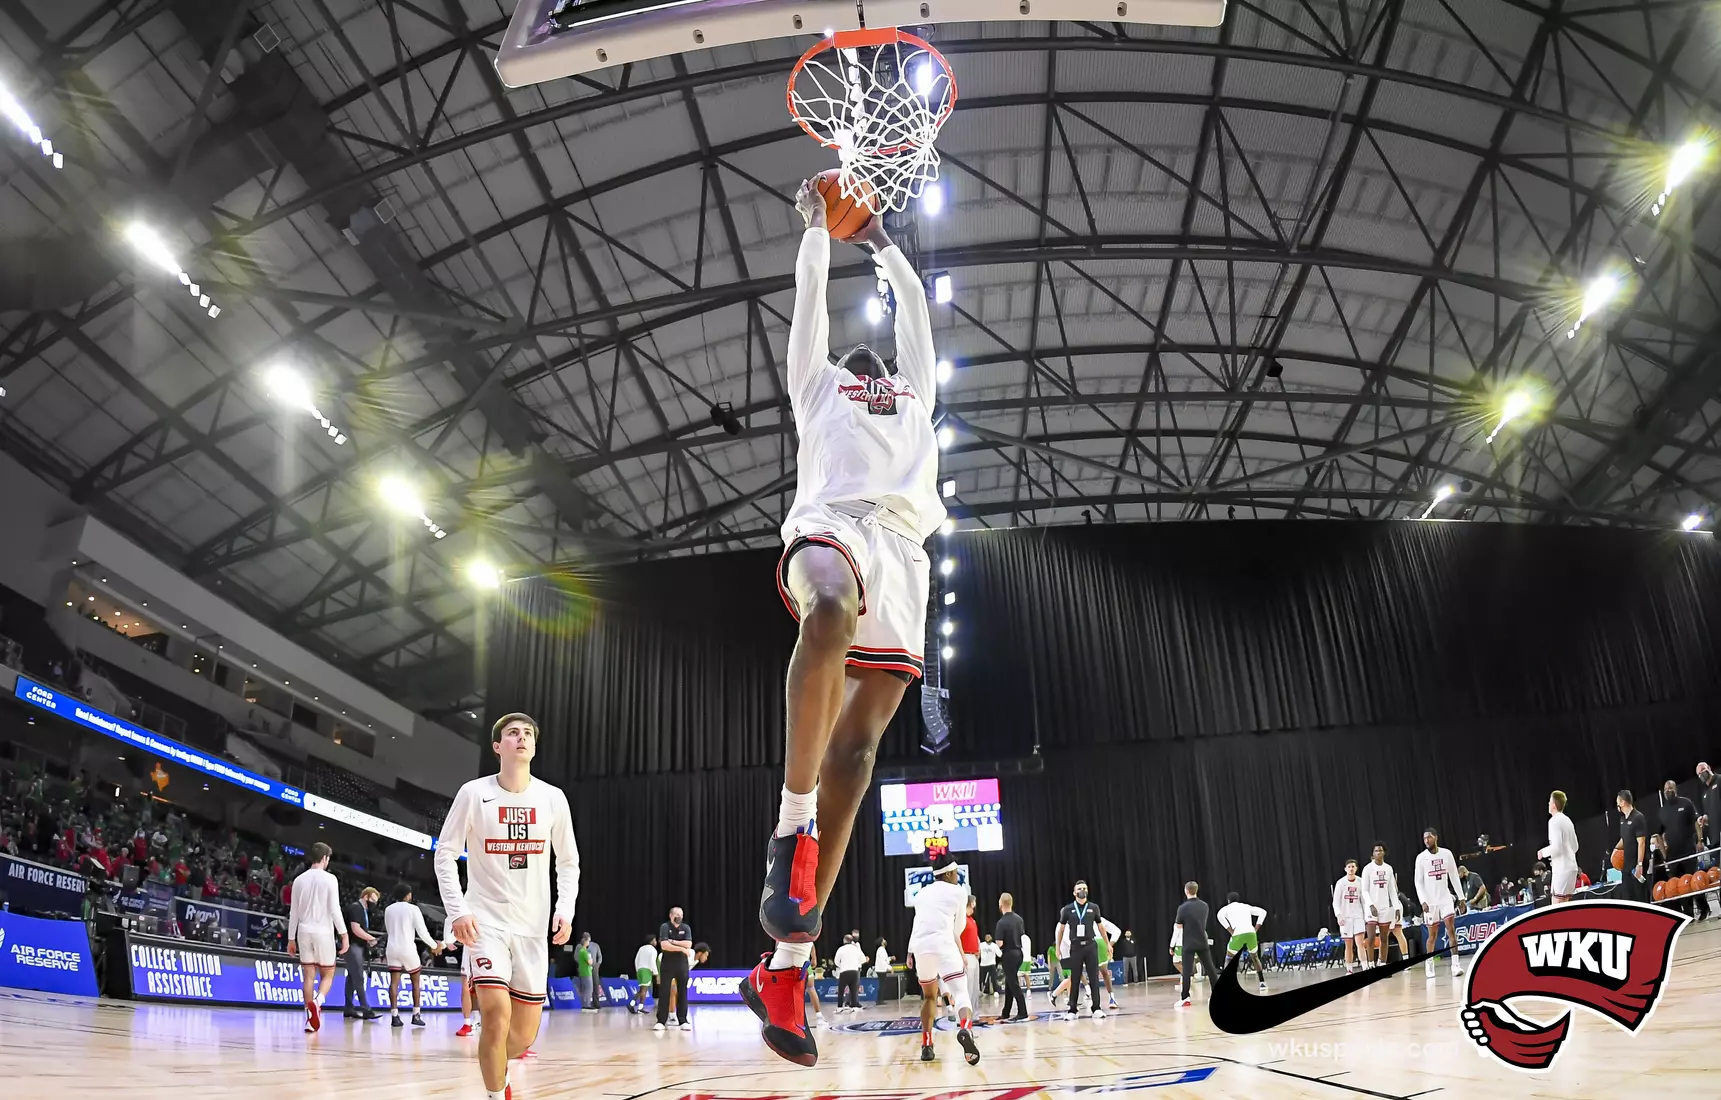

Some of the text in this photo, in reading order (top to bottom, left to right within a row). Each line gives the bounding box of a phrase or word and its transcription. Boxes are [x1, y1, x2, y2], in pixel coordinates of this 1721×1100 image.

[26, 692, 57, 709] CENTER
[32, 686, 53, 700] FORD
[503, 807, 532, 823] JUST
[510, 824, 526, 840] US
[486, 842, 516, 852] WESTERN
[8, 862, 25, 879] AIR
[27, 868, 54, 887] FORCE
[10, 944, 81, 963] AIR FORCE
[130, 945, 222, 976] COLLEGE TUITION
[16, 954, 79, 971] RESERVE
[147, 971, 214, 998] ASSISTANCE
[400, 973, 449, 991] FRCE
[377, 989, 449, 1007] RSRVE
